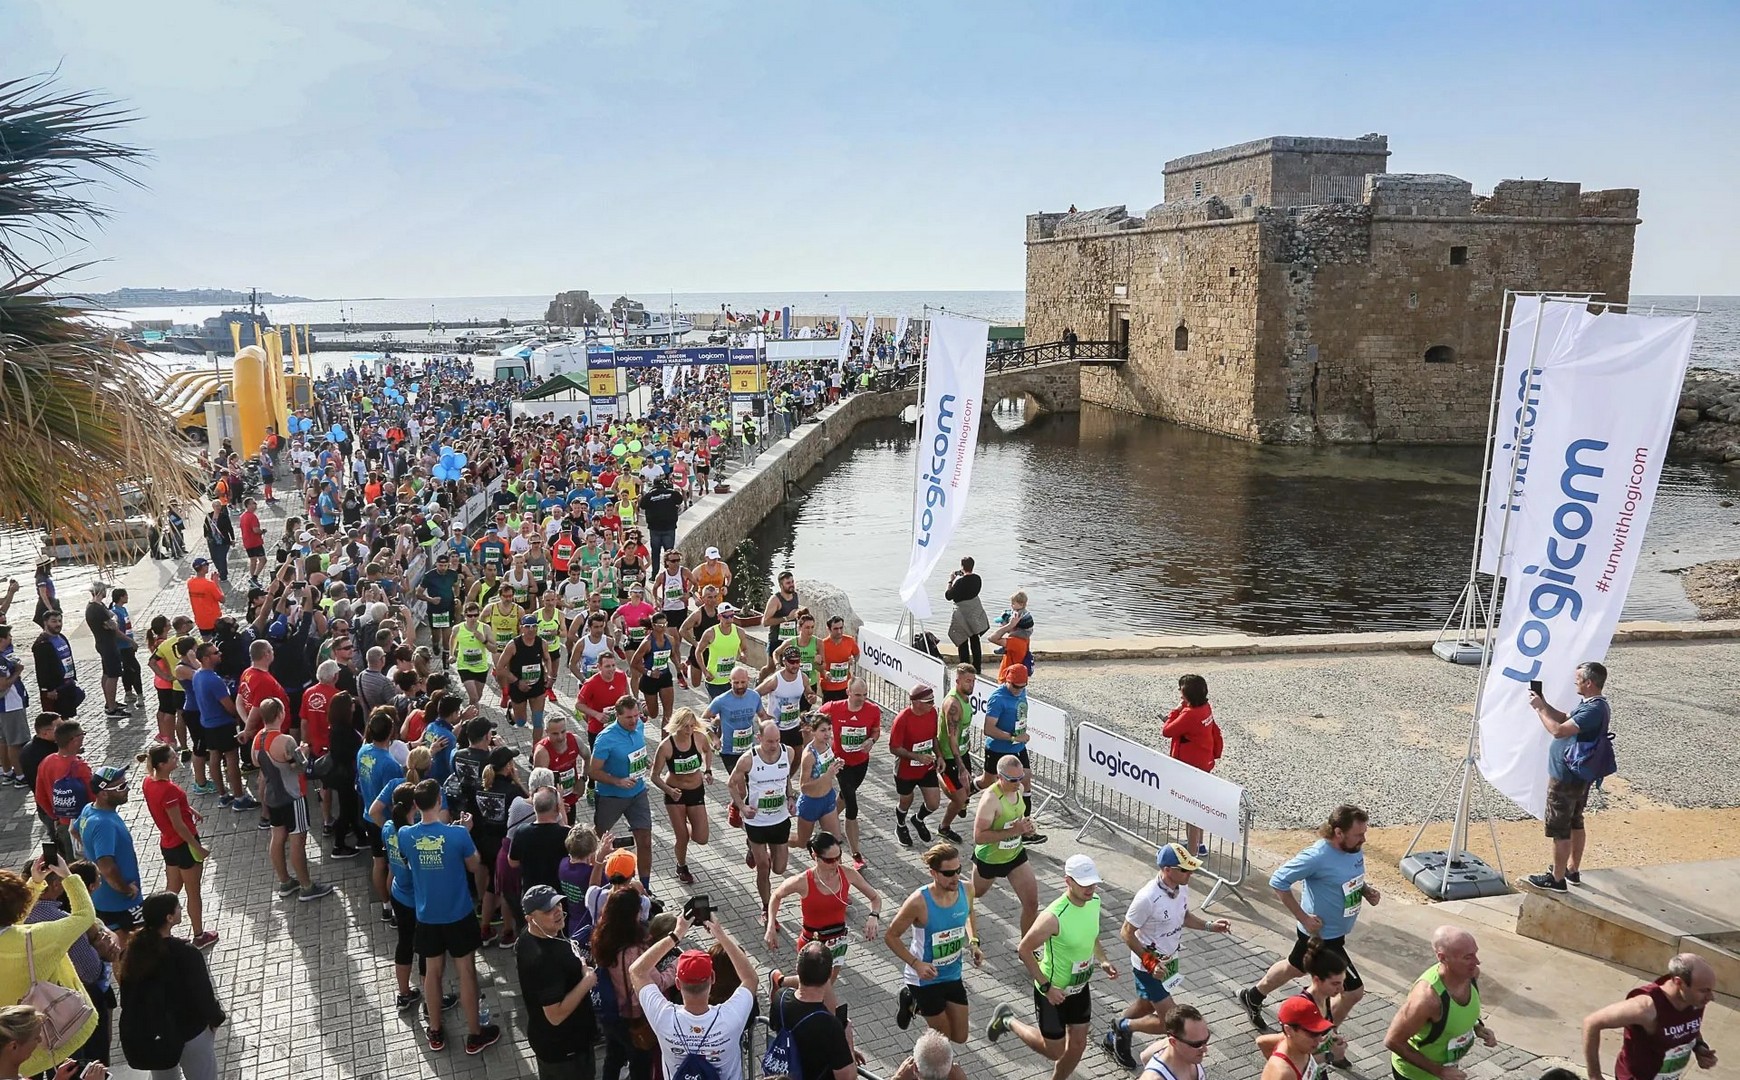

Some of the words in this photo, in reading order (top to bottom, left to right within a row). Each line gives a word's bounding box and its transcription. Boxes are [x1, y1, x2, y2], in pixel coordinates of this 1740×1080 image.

[590, 357, 612, 366] Logicom
[617, 354, 643, 363] Logicom
[698, 352, 724, 361] Logicom
[951, 398, 974, 488] #runwithlogicom
[917, 393, 956, 548] Logicom
[1595, 446, 1649, 594] #runwithlogicom
[1501, 438, 1610, 683] Logicom
[863, 641, 903, 673] Logicom
[680, 760, 697, 771] 1492
[1088, 742, 1160, 790] Logicom
[1169, 787, 1228, 820] #runwithlogicom
[938, 940, 961, 958] 1730
[1664, 1024, 1684, 1036] LOW
